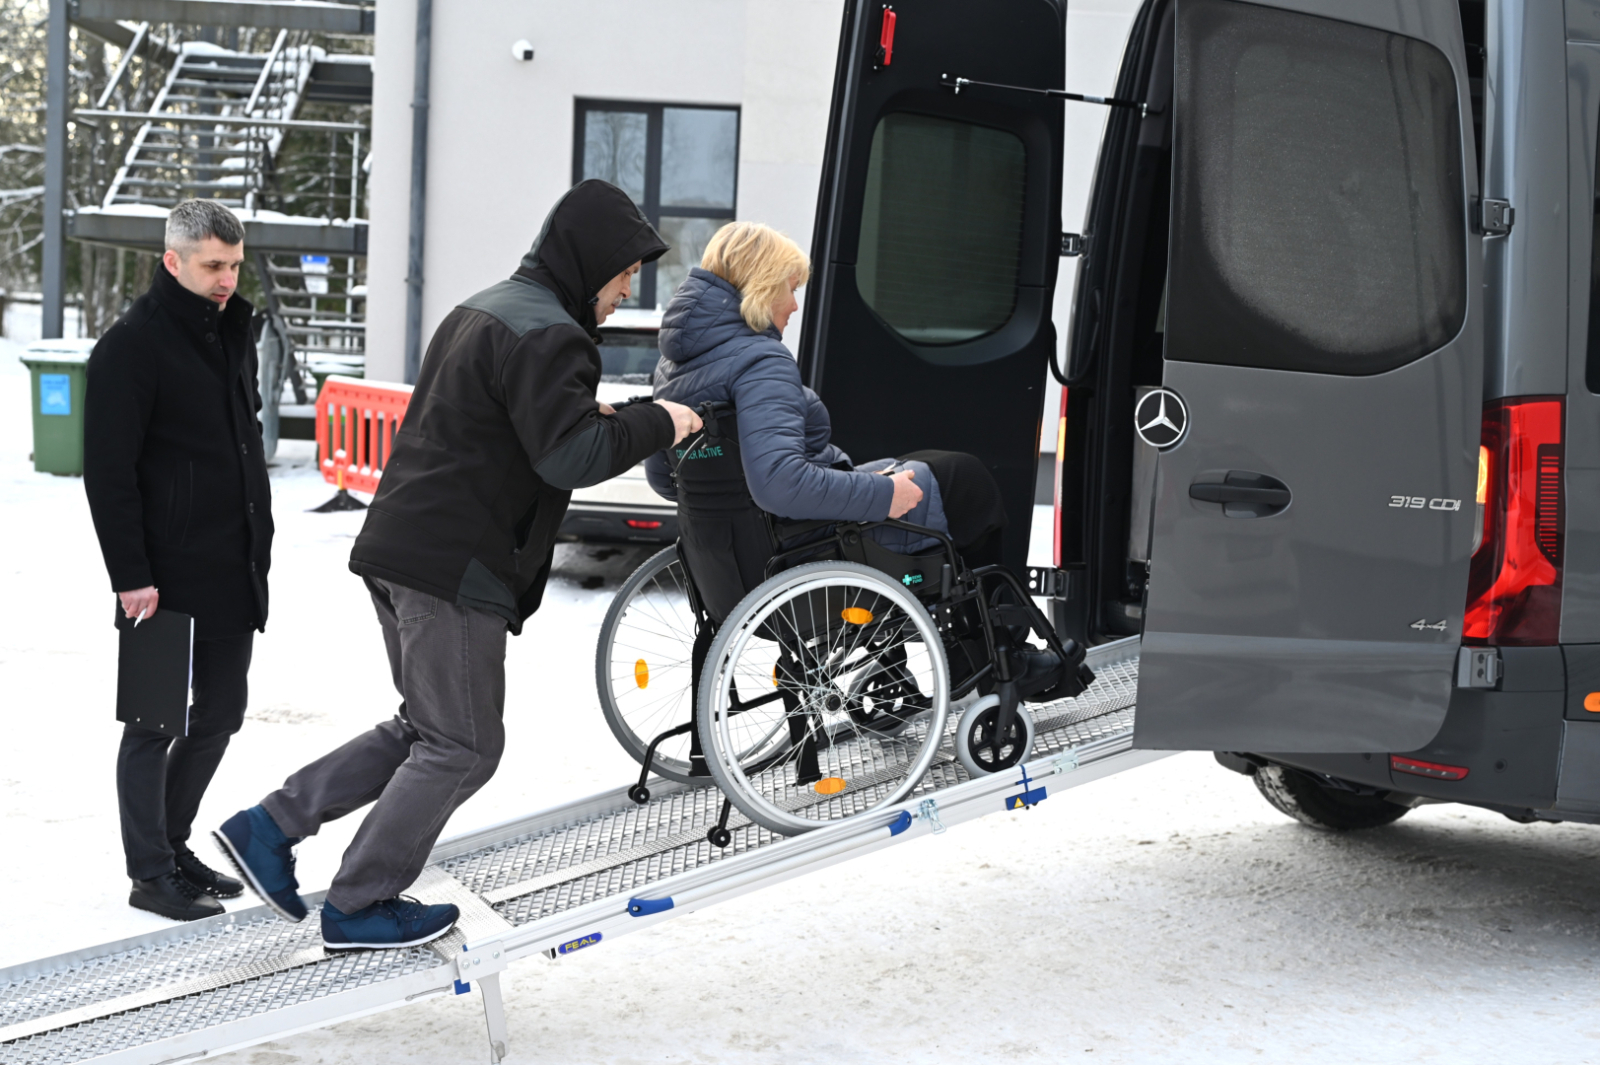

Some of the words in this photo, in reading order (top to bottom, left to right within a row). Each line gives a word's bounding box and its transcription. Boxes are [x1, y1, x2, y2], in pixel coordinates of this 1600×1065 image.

[697, 446, 724, 459] ACTIVE
[1388, 495, 1426, 509] 319
[1429, 498, 1462, 511] CDI
[1410, 618, 1447, 631] 4x4
[565, 936, 597, 951] FEAL
